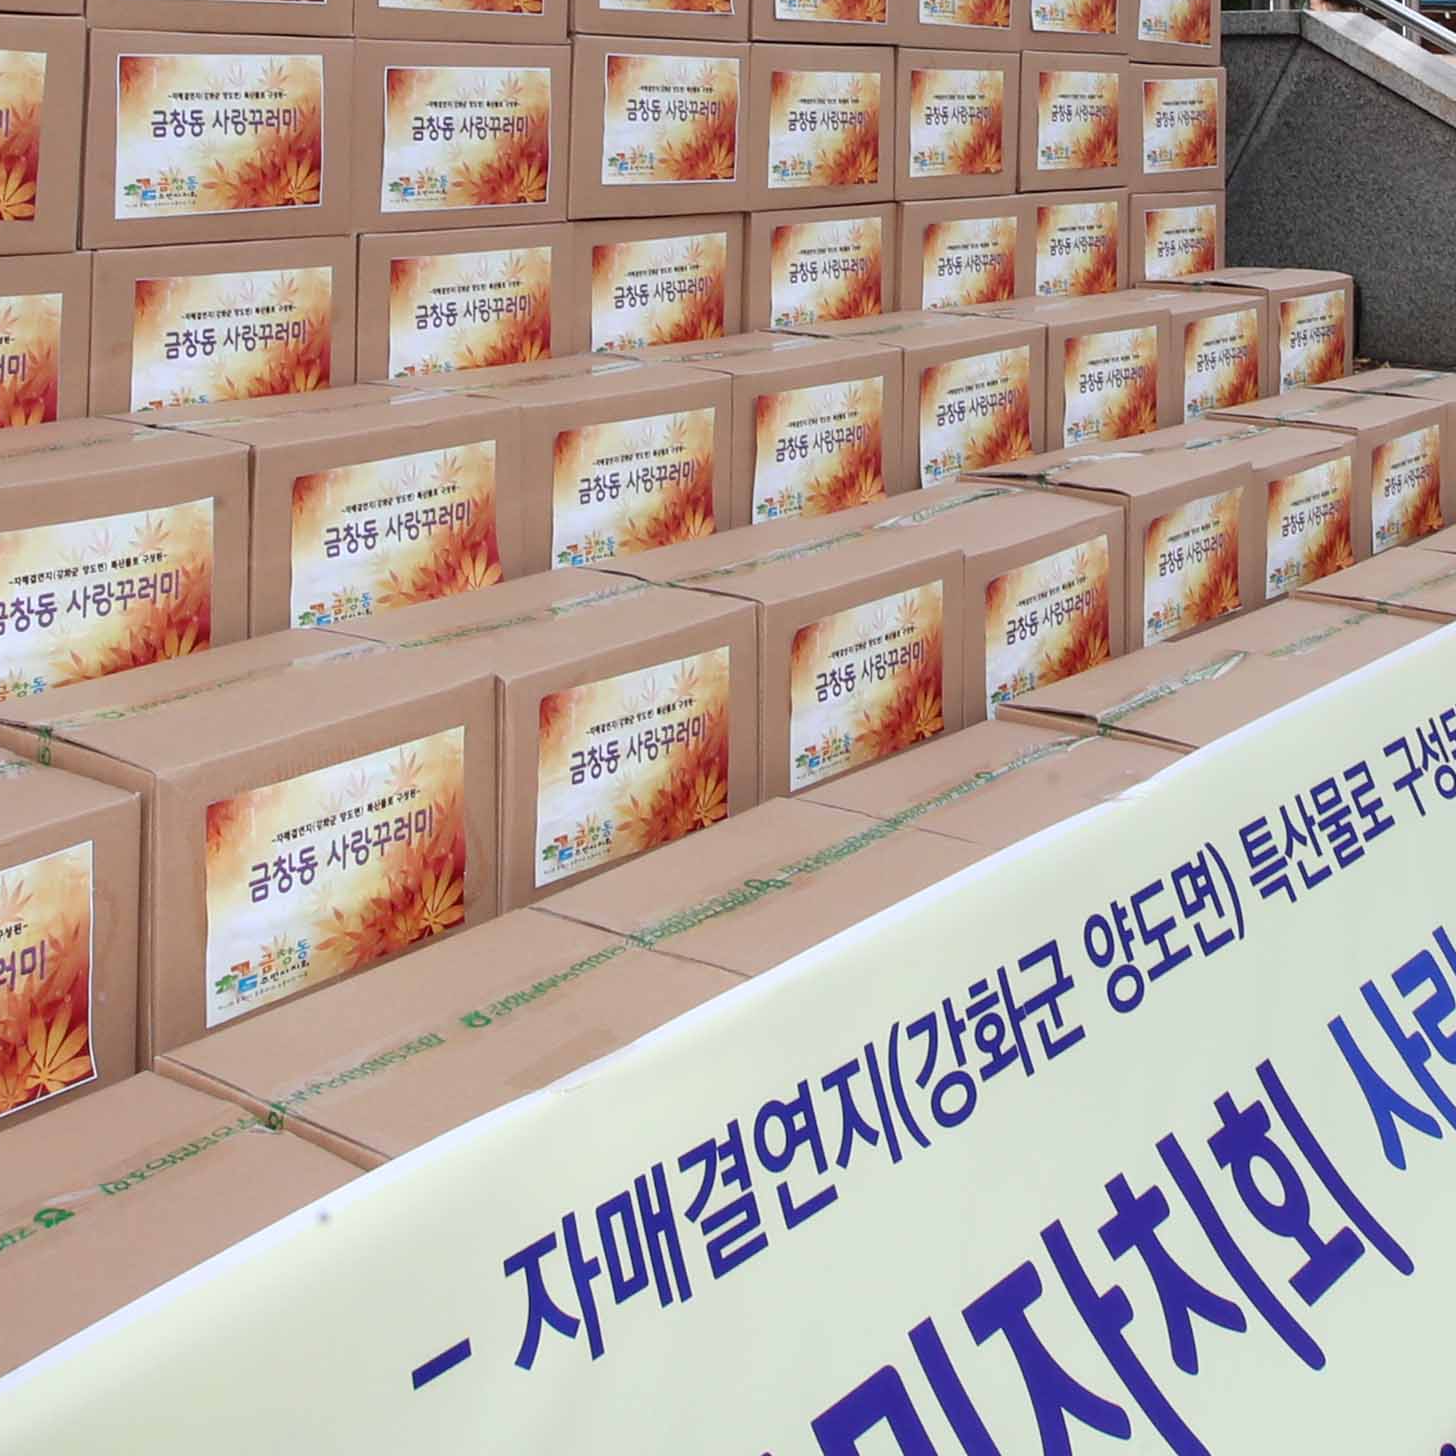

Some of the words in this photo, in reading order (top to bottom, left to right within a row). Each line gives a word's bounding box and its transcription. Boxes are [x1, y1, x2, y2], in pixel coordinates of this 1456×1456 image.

[150, 108, 207, 140] 금창동
[211, 107, 299, 137] 사랑꾸러미
[410, 114, 457, 143] 금창동
[459, 115, 530, 142] 사랑꾸러미
[625, 97, 664, 124] 금창동
[665, 99, 723, 123] 사랑꾸러미
[414, 300, 460, 332] 금창동
[463, 294, 533, 324] 사랑꾸러미
[613, 282, 651, 312] 금창동
[653, 277, 710, 304] 사랑꾸러미
[163, 327, 219, 362] 금창동
[222, 320, 309, 353] 사랑꾸러미
[774, 433, 811, 465] 금창동
[812, 424, 868, 455] 사랑꾸러미
[577, 471, 623, 507] 금창동
[626, 460, 696, 494] 사랑꾸러미
[323, 518, 381, 561] 금창동
[385, 500, 473, 542] 사랑꾸러미
[67, 570, 181, 619] 사랑꾸러미
[1005, 609, 1041, 648] 금창동
[1042, 588, 1096, 628] 사랑꾸러미
[815, 662, 858, 705] 금창동
[860, 639, 926, 683] 사랑꾸러미
[569, 739, 622, 787] 금창동
[626, 714, 708, 764] 사랑꾸러미
[248, 844, 320, 905] 금창동
[326, 806, 435, 870] 사랑꾸러미
[504, 939, 1085, 1368] 자매결연지(강화군
[1084, 841, 1246, 1014] 양도면)
[1239, 758, 1395, 904] 특산물로
